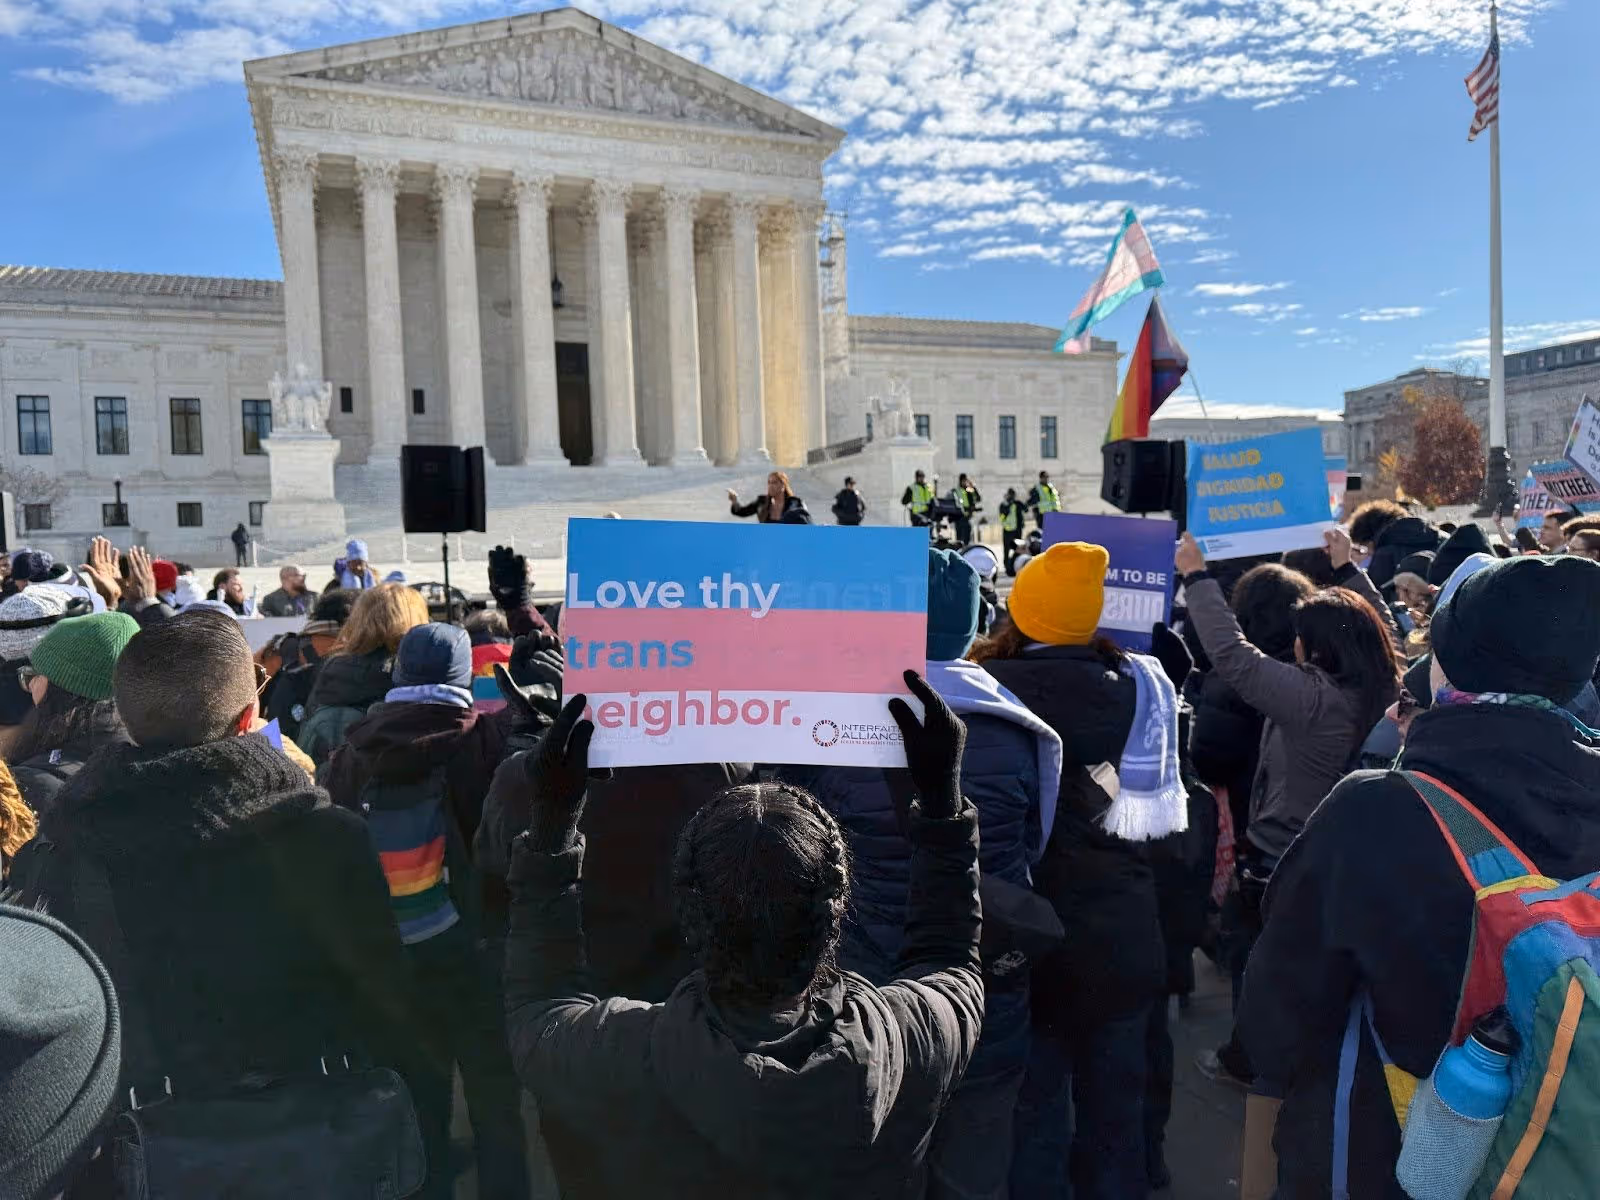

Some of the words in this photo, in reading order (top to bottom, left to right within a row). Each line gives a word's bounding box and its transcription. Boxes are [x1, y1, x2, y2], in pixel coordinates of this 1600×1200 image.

[1121, 569, 1143, 583] TO
[1145, 571, 1167, 586] BE
[568, 572, 685, 609] Love
[699, 572, 781, 619] thy
[563, 635, 694, 670] trans
[841, 724, 900, 732] INTERFAIT
[841, 732, 904, 741] ALLIANCE
